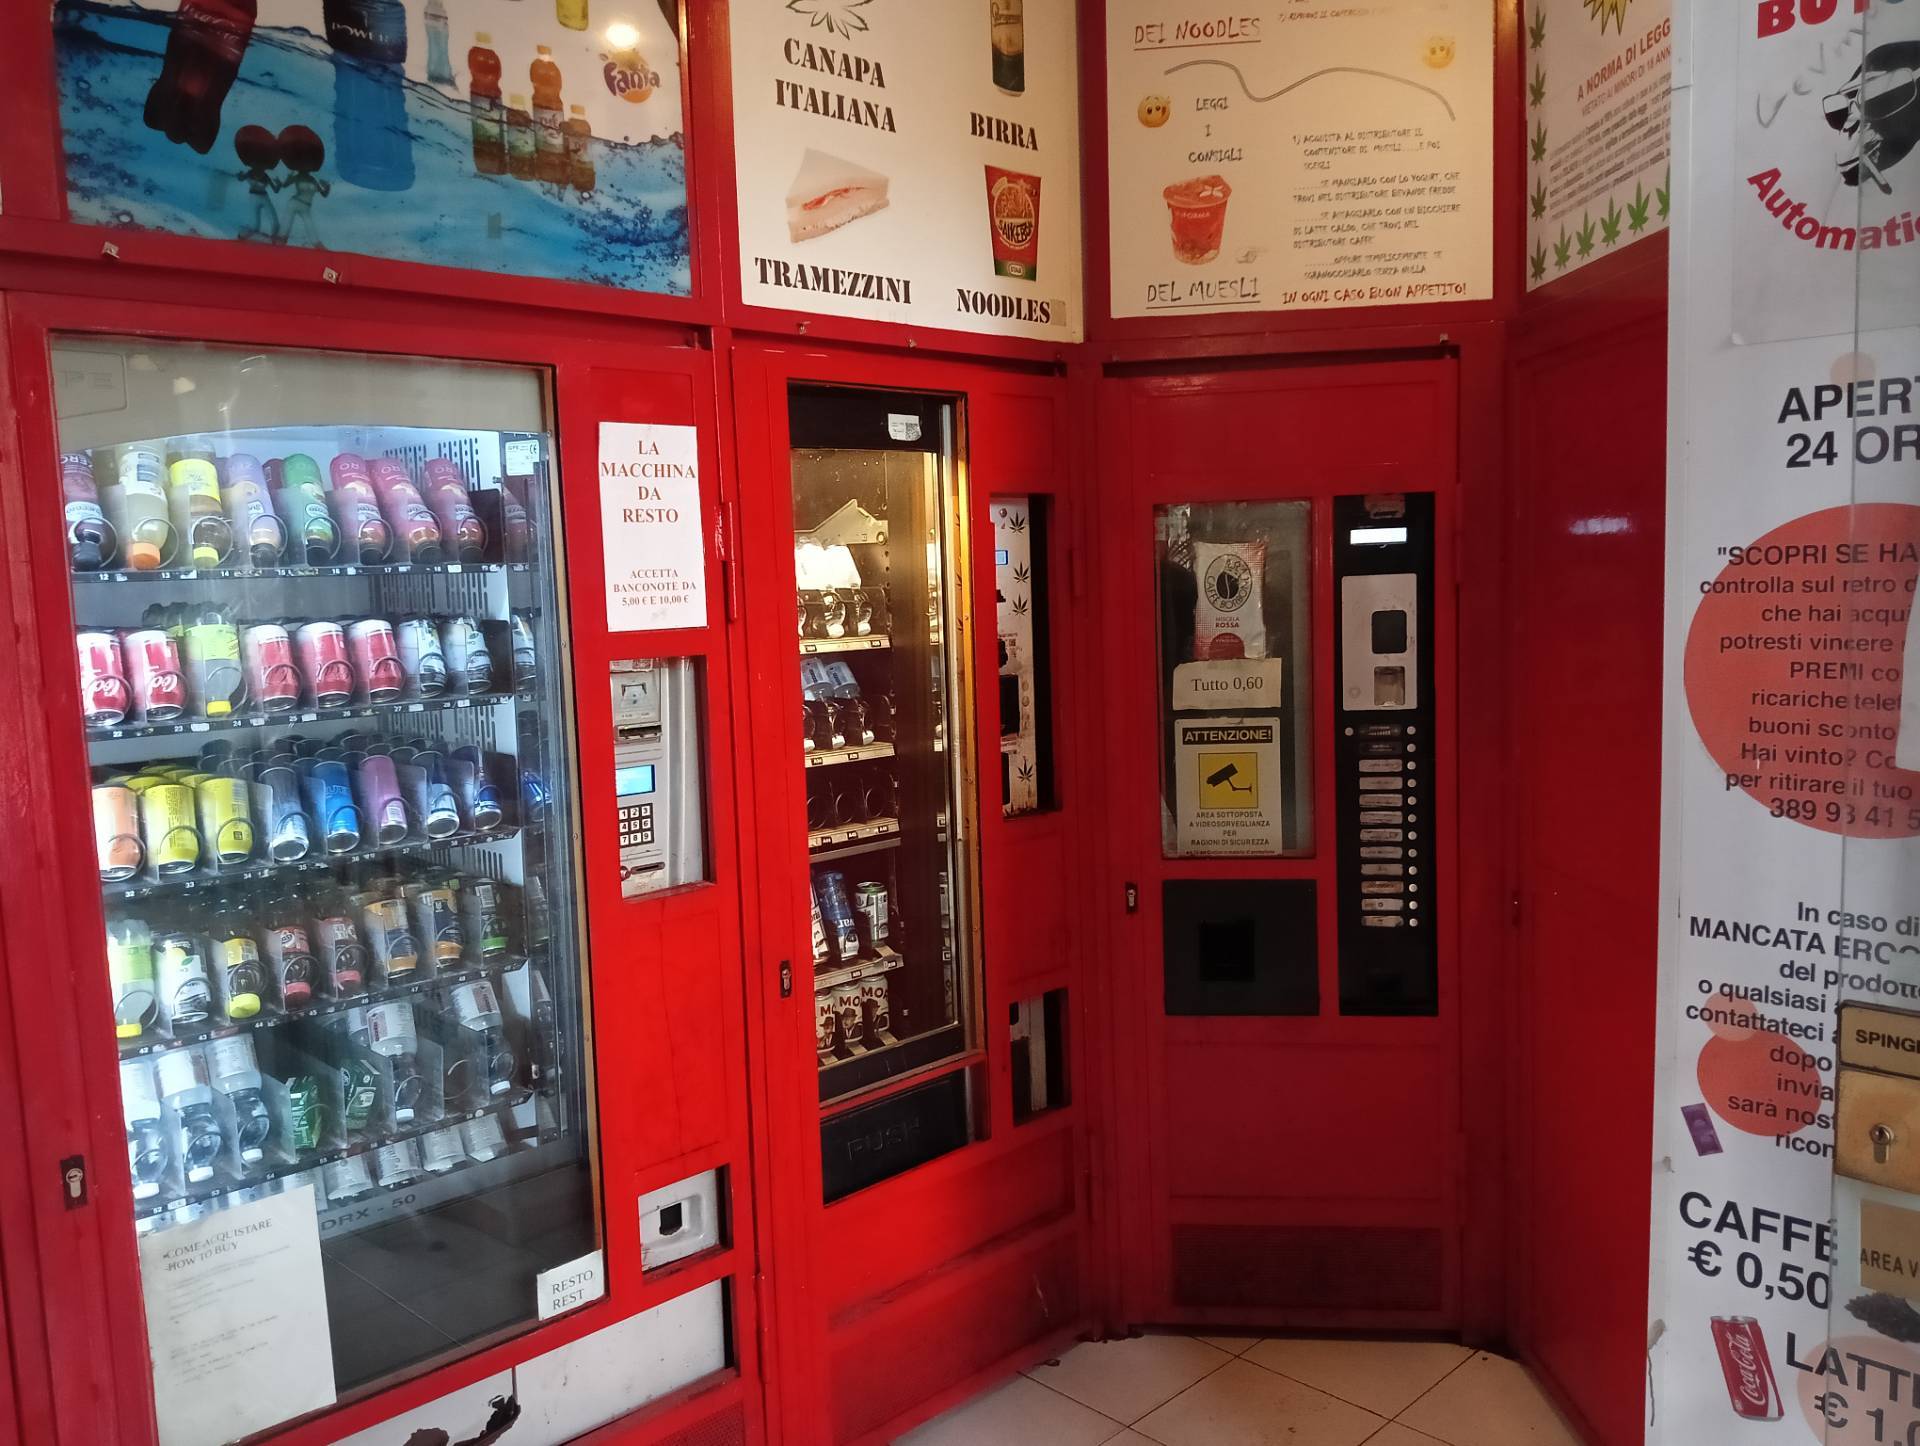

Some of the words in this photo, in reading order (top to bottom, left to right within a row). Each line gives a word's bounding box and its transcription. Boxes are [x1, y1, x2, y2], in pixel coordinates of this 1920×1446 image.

[1134, 24, 1165, 43] DEI
[1175, 17, 1261, 40] NOODLES
[784, 38, 885, 88] CANAPA
[1577, 84, 1584, 102] A
[1586, 55, 1622, 95] NORMA
[1625, 43, 1637, 65] DI
[775, 79, 896, 132] ITALIANA
[1195, 96, 1229, 111] LEGGI
[970, 112, 1038, 151] BIRRA
[1188, 147, 1243, 162] CONSIGLI
[755, 257, 912, 305] TRAMEZZINI
[1147, 280, 1181, 302] DEL
[1189, 277, 1260, 300] MUESLI
[1282, 290, 1297, 304] IN
[1301, 289, 1329, 303] OGNI
[1334, 288, 1364, 302] CASO
[1369, 286, 1402, 299] BUON
[1406, 282, 1466, 298] APPETITO!
[957, 289, 1050, 324] NOODLES
[1777, 375, 1920, 424] APER
[638, 440, 660, 455] LA
[1786, 431, 1838, 468] 24
[601, 462, 696, 479] MACCHINA
[638, 486, 661, 501] DA
[623, 508, 679, 523] RESTO
[1717, 545, 1827, 566] "SCOPRI
[1836, 543, 1869, 563] SE
[630, 569, 679, 579] ACCETTA
[1700, 577, 1794, 594] controlla
[1801, 576, 1835, 593] sul
[1843, 576, 1897, 593] retro
[613, 582, 678, 593] BANCONOTE
[682, 581, 697, 590] DA
[621, 596, 640, 606] 5,00
[660, 595, 681, 605] 10,00
[1761, 605, 1801, 622] che
[1808, 604, 1841, 622] hai
[1720, 634, 1801, 654] potresti
[1809, 634, 1893, 652] vincere
[1790, 662, 1863, 680] PREMI
[1191, 678, 1228, 692] Tutto
[1233, 676, 1263, 692] 0,60
[1751, 689, 1847, 709] ricariche
[1184, 729, 1271, 741] ATTENZIONE!
[1748, 717, 1811, 736] buoni
[1818, 722, 1896, 741] sconto
[1741, 743, 1777, 761] Hai
[1785, 745, 1857, 767] vinto?
[1726, 773, 1761, 791] per
[1769, 772, 1845, 794] ritirare
[1852, 778, 1864, 796] il
[1873, 780, 1913, 800] tuo
[632, 808, 638, 816] 2
[1769, 797, 1816, 820] 389
[1864, 806, 1893, 828] 41
[632, 821, 638, 829] 5
[633, 834, 638, 842] 8
[1191, 838, 1220, 846] RAGIONI
[1798, 901, 1819, 923] In
[1827, 910, 1888, 932] caso
[1895, 915, 1919, 937] di
[1690, 916, 1826, 955] MANCATA
[1779, 960, 1816, 982] del
[1699, 979, 1712, 994] o
[1720, 981, 1826, 1013] qualsiasi
[1686, 1005, 1824, 1042] contattateci
[1769, 1045, 1832, 1072] dopo
[1777, 1073, 1833, 1101] invia
[1728, 1095, 1777, 1118] sarà
[1786, 1107, 1835, 1130] nos
[321, 1207, 369, 1231] DRX
[392, 1194, 416, 1208] 50
[214, 1241, 239, 1255] BUY
[1861, 1248, 1904, 1275] AREA
[552, 1269, 593, 1294] RESTO
[1687, 1240, 1722, 1278] €
[1736, 1251, 1832, 1310] 0,50
[552, 1288, 584, 1310] REST
[1814, 1391, 1848, 1429] €
